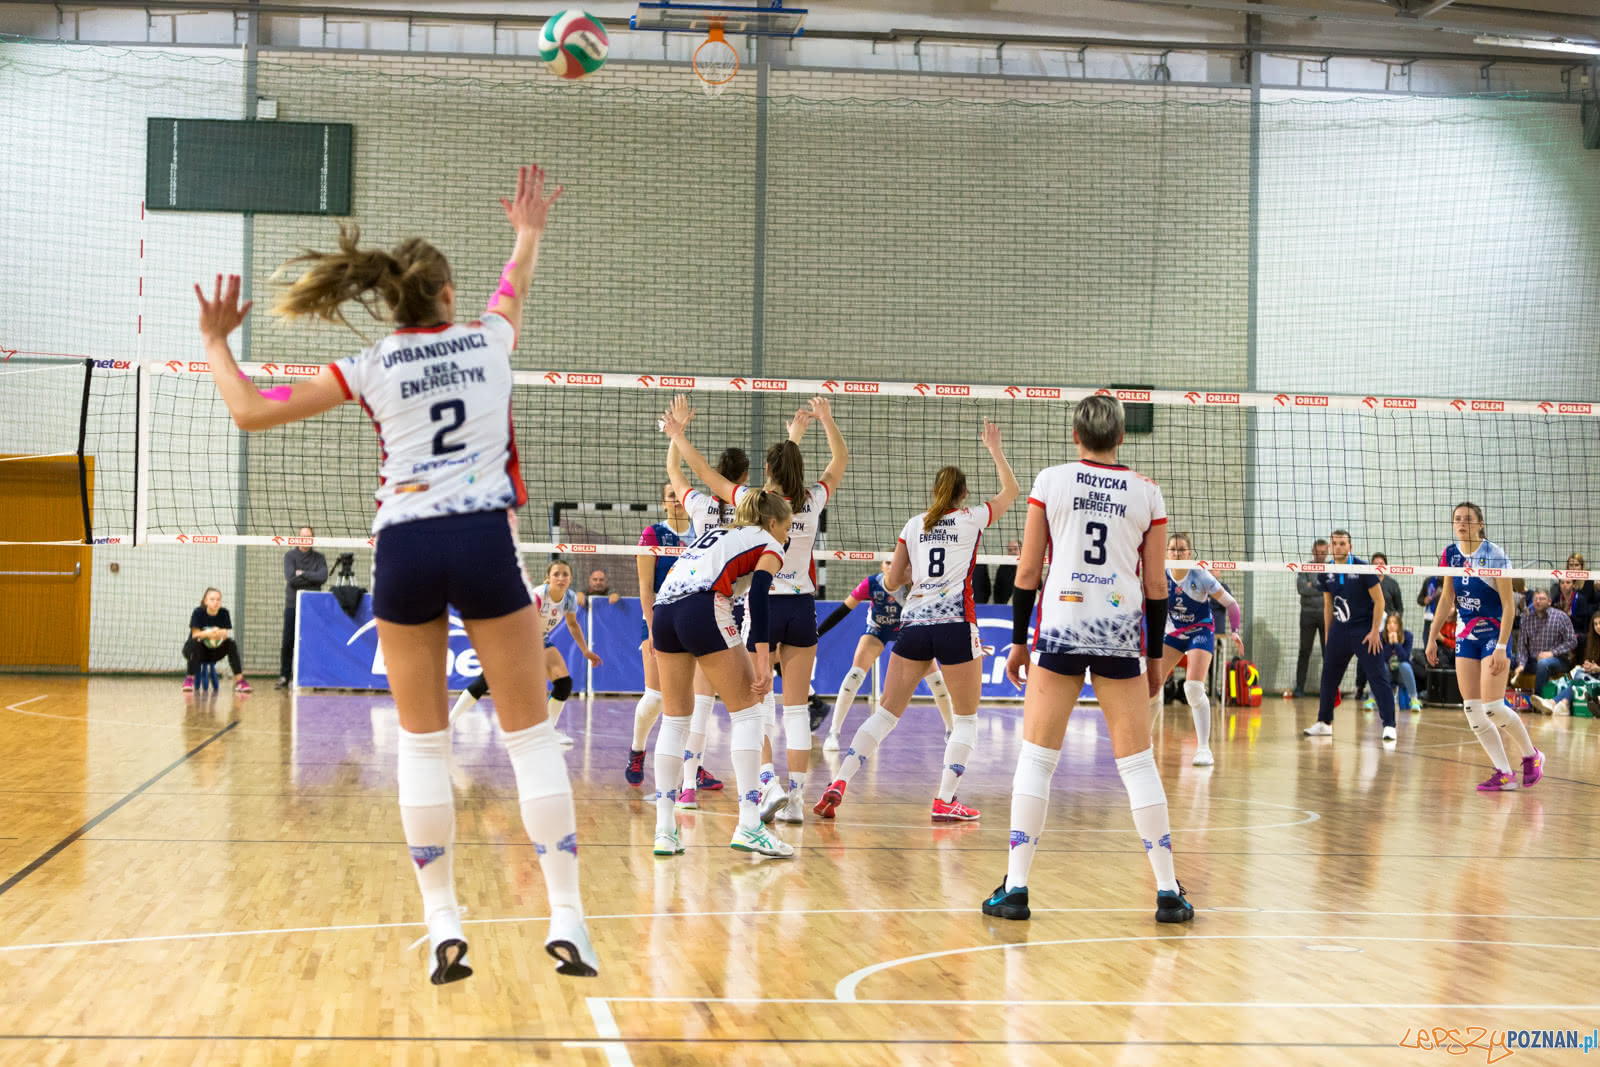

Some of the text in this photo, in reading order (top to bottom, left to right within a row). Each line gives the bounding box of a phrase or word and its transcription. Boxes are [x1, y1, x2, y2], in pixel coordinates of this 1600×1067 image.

[382, 333, 488, 368] URBANOWICZ
[92, 358, 130, 369] netex
[190, 363, 210, 372] ORL
[285, 366, 319, 376] ORLEN
[423, 361, 459, 377] ENEA
[400, 367, 486, 399] ENERGETYK
[568, 374, 602, 384] ORLEN
[661, 377, 694, 387] ORLEN
[753, 380, 786, 390] ORLEN
[845, 382, 878, 392] ORLEN
[936, 385, 970, 395] ORLEN
[1027, 388, 1059, 398] ORLEN
[1118, 390, 1152, 401] ORLEN
[1207, 393, 1240, 403] ORLEN
[1296, 396, 1328, 406] ORLEN
[1384, 398, 1415, 408] ORLEN
[1472, 401, 1503, 411] ORLEN
[1559, 404, 1591, 413] ORLEN
[429, 398, 467, 456] 2
[1076, 472, 1128, 491] RÓŻYCKA
[1088, 491, 1111, 502] ENEA
[1073, 497, 1127, 518] ENERGETYK
[193, 535, 218, 544] ORLEN
[288, 537, 313, 545] ORLEN
[689, 529, 729, 549] 16
[919, 533, 959, 543] ENERGETYK
[1084, 521, 1108, 566] 3
[928, 547, 946, 577] 8
[724, 625, 737, 638] 16
